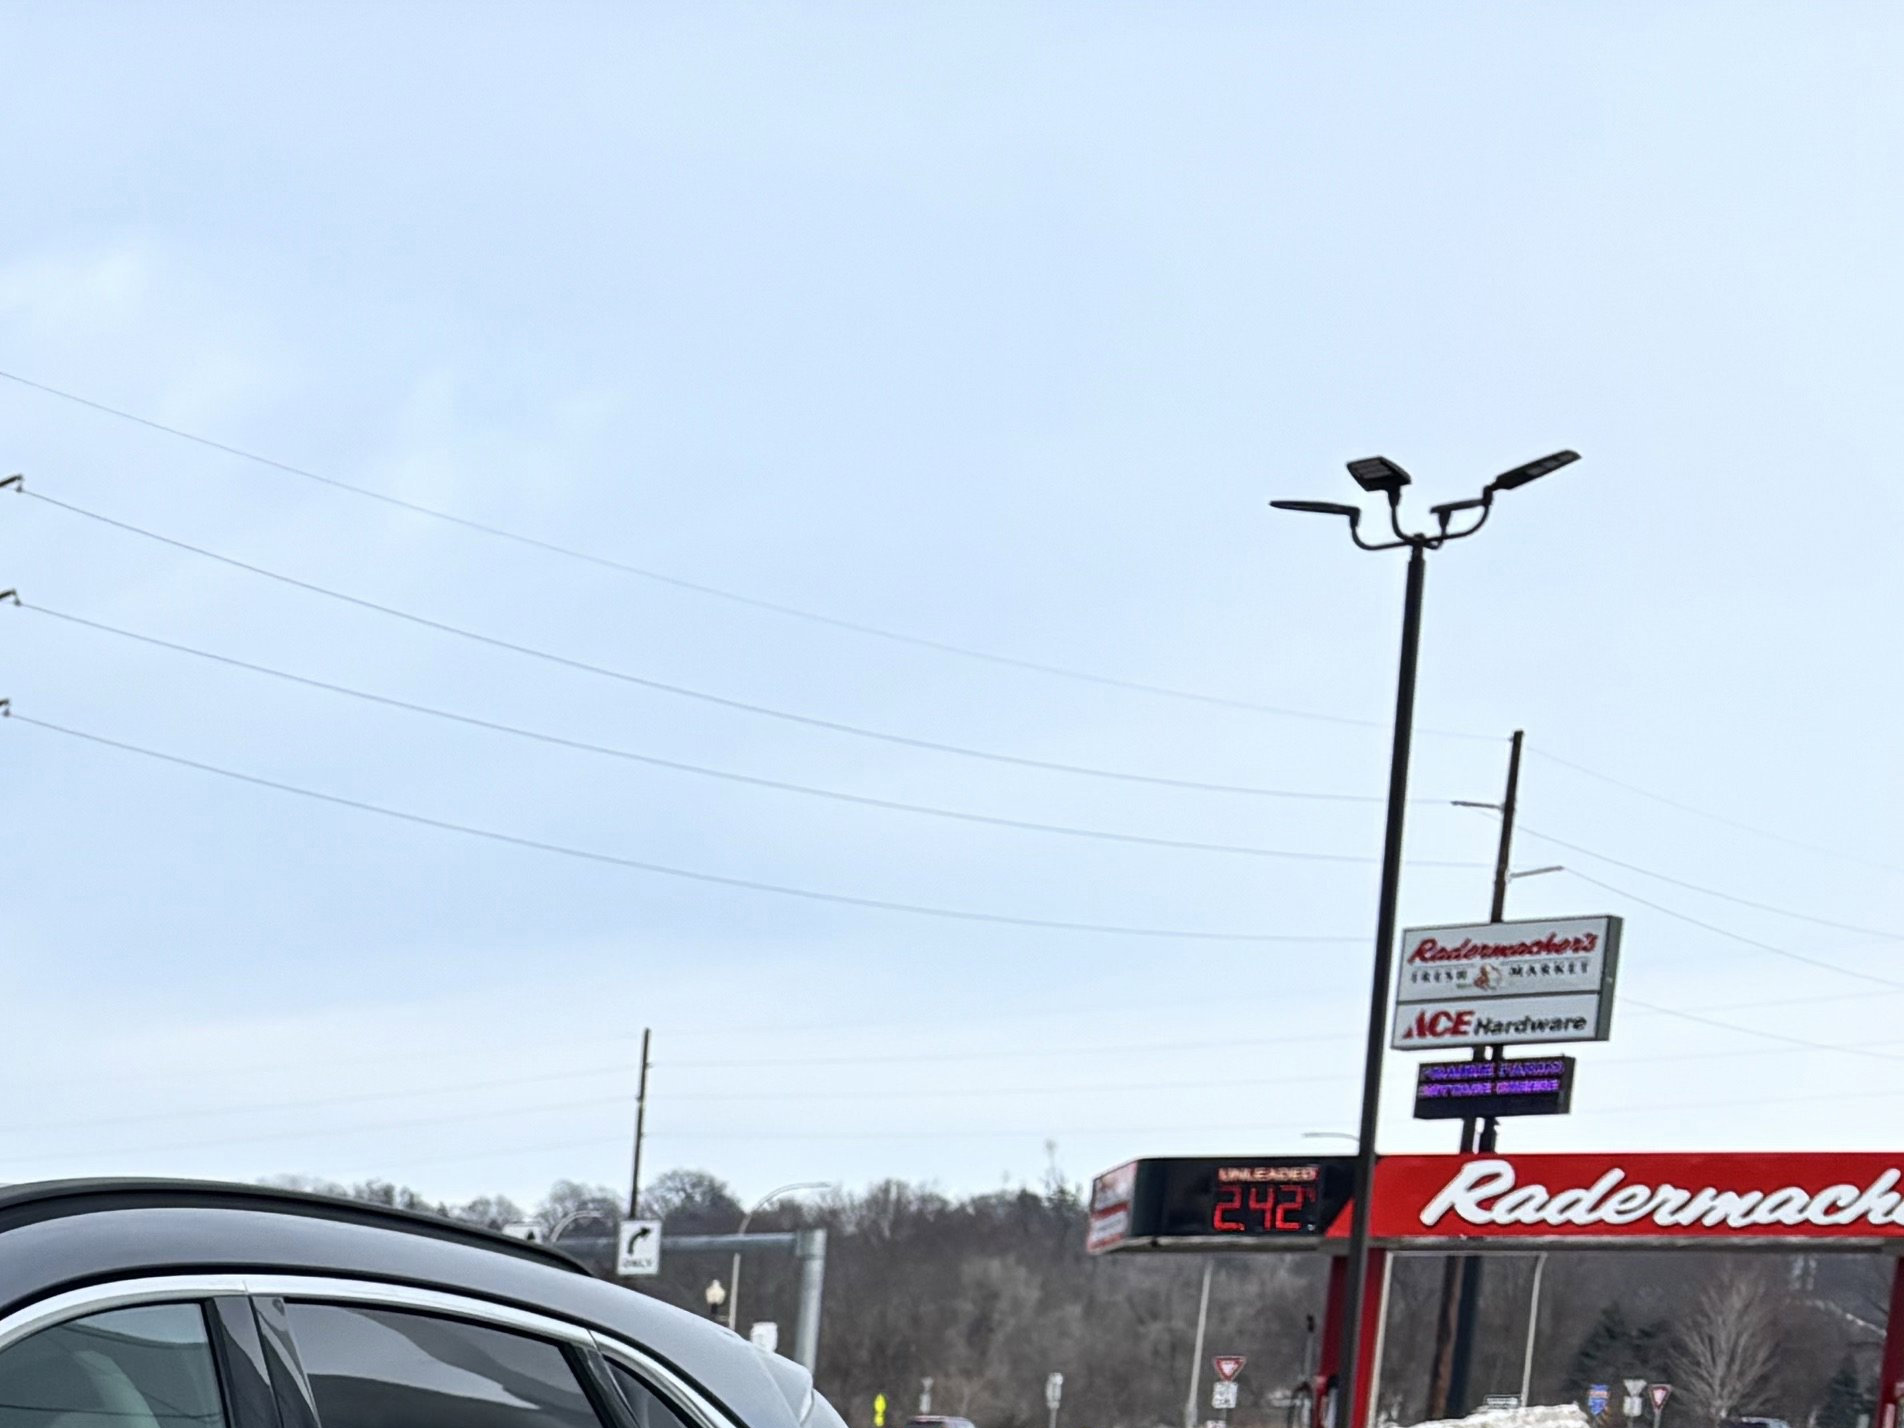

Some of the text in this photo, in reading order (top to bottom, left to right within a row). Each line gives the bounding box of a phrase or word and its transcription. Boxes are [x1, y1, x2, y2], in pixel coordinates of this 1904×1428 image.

[1407, 932, 1598, 964] Radermacher's
[1509, 961, 1589, 977] MARKET
[1402, 1008, 1587, 1040] ACE Hardware
[1218, 1166, 1319, 1182] UNLEADED
